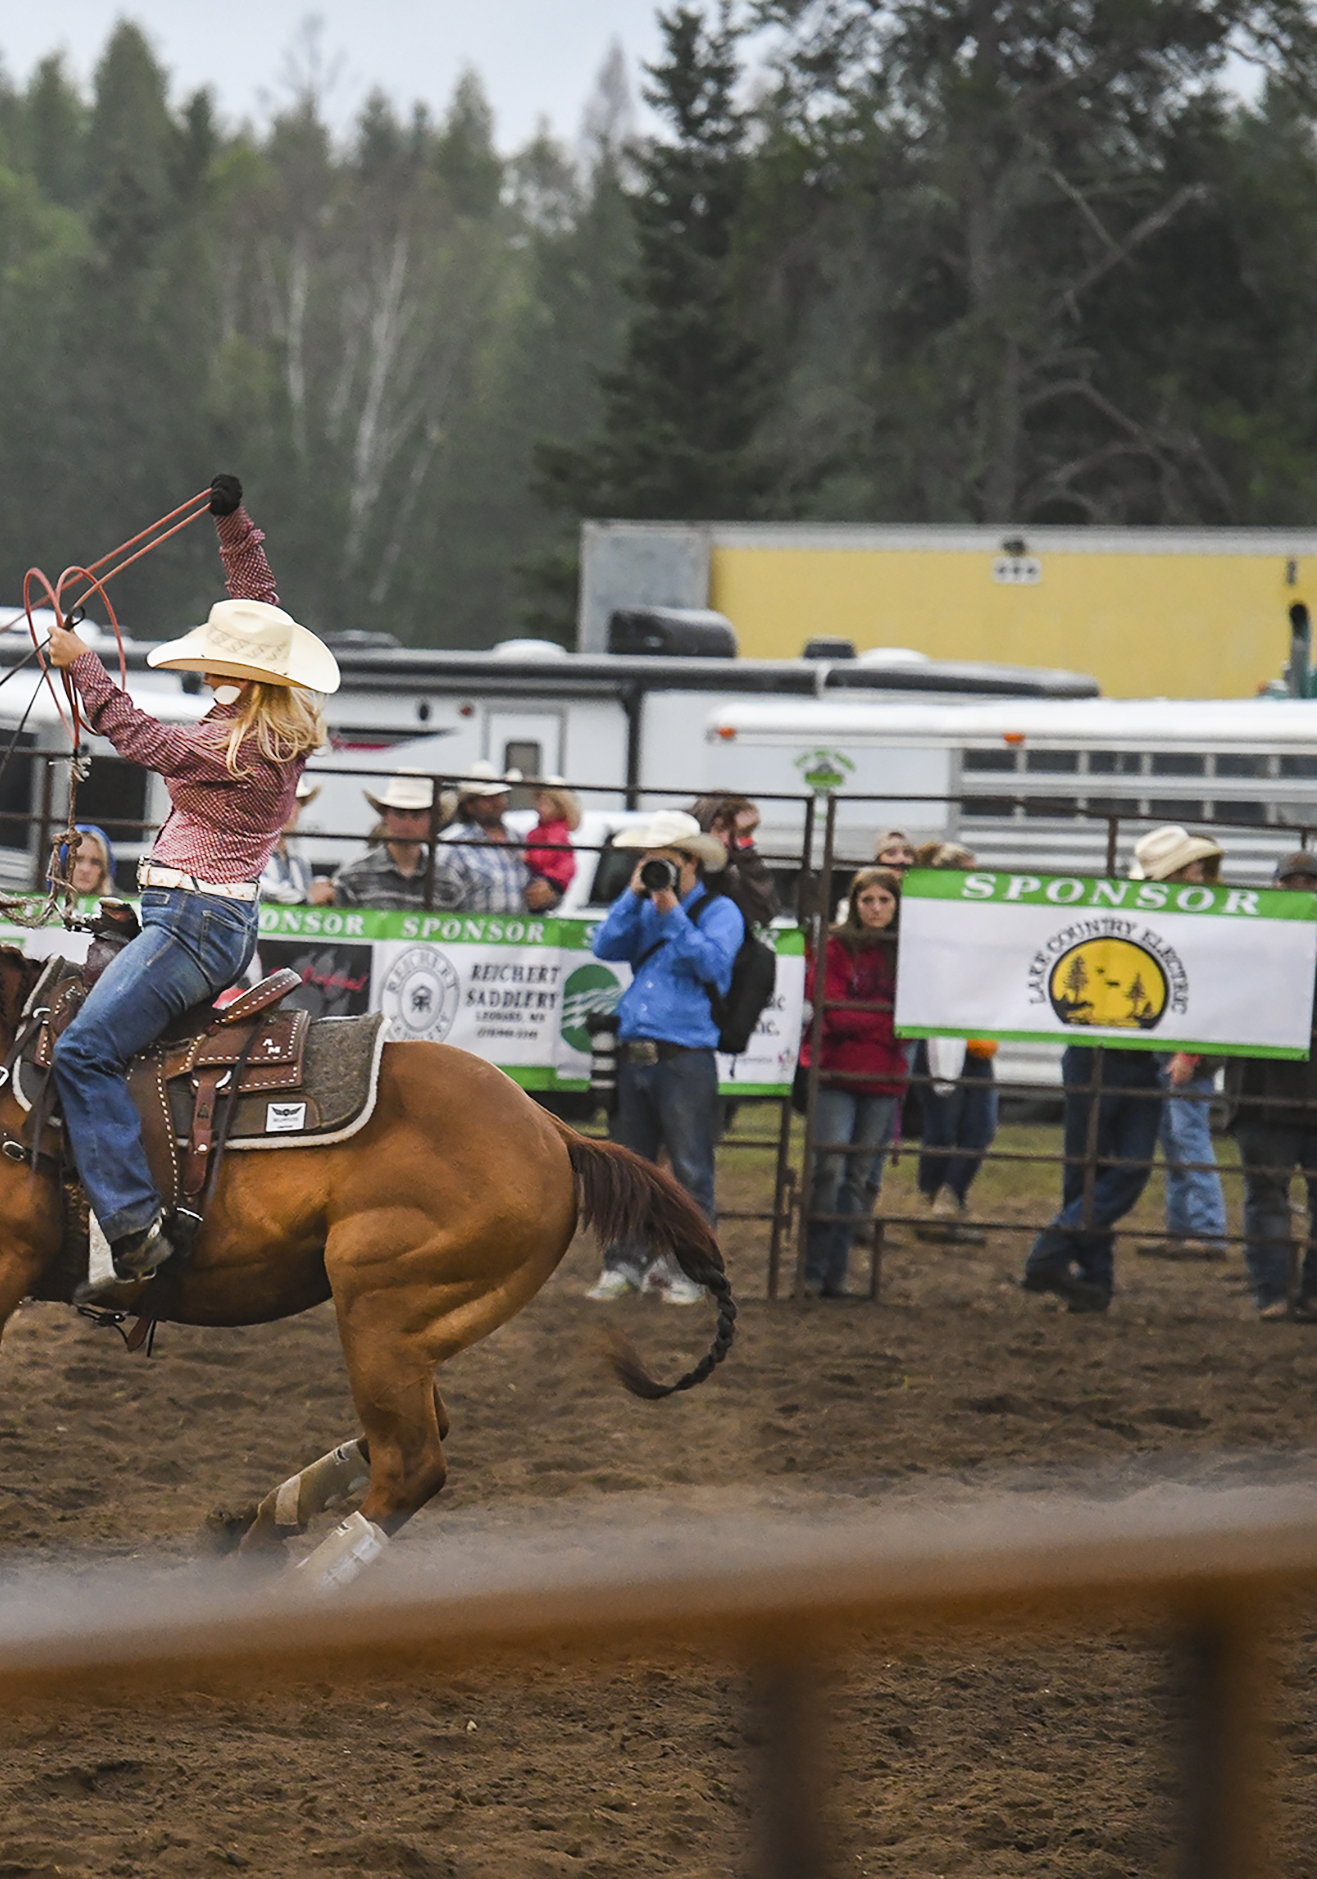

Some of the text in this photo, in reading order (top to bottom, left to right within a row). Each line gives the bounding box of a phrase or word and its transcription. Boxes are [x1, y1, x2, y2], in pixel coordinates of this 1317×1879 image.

[961, 872, 1261, 916] SPONSOR
[258, 908, 365, 936] ONSOR
[402, 916, 545, 943] SPONSOR
[471, 962, 561, 985] REICHERT
[1028, 917, 1189, 1015] LAKE COUNTRY ELECTRIC
[465, 988, 559, 1011] SADDLERY
